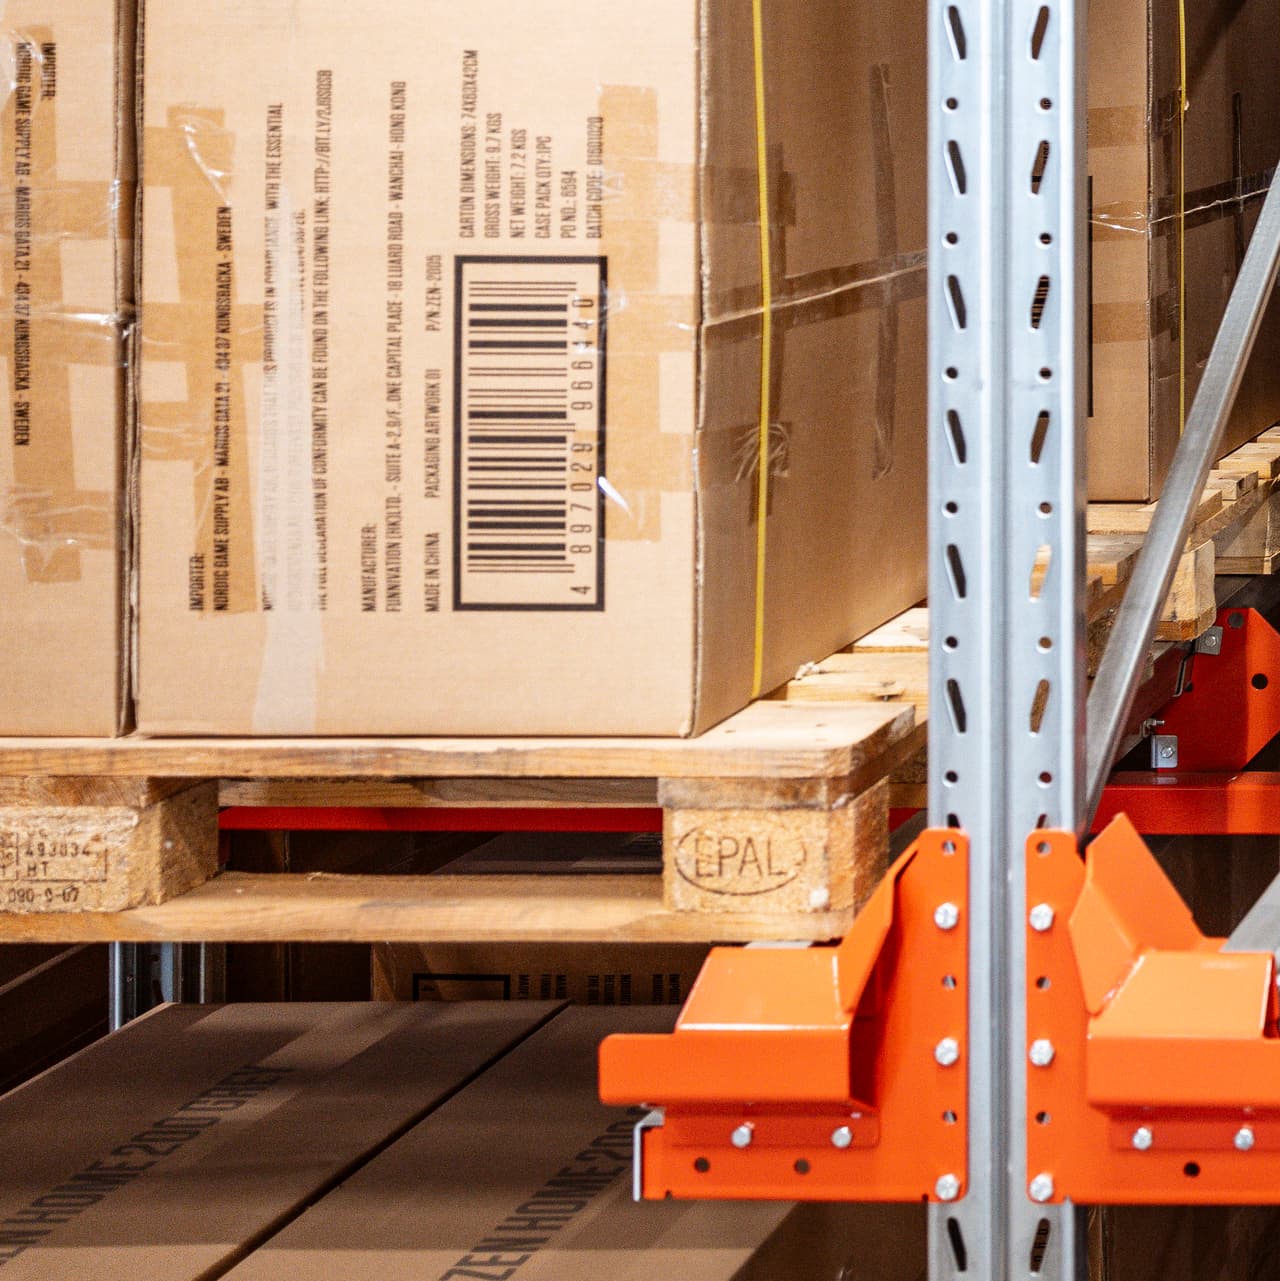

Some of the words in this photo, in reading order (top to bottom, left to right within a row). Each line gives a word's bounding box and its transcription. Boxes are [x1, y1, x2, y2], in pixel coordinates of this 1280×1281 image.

[41, 42, 56, 100] IMPORTER:
[387, 82, 406, 110] KONG
[265, 105, 282, 158] ESSENTIAL
[484, 112, 502, 133] KGS
[510, 129, 527, 149] KGS
[484, 136, 502, 152] 9.7
[585, 116, 604, 164] 01601020
[265, 162, 282, 178] THE
[459, 126, 478, 192] DIMENSIONS:
[510, 152, 527, 168] 7.2
[484, 156, 502, 199] WEIGHT:
[510, 173, 527, 215] WEIGHT:
[560, 170, 578, 196] 6594
[585, 170, 604, 201] CODE:
[265, 183, 282, 208] WITH
[534, 181, 552, 208] PACK
[560, 200, 577, 220] NO.:
[215, 207, 232, 251] SWEDEN
[387, 212, 405, 240] ROAD
[459, 196, 477, 237] CARTON
[484, 202, 502, 237] GROSS
[510, 219, 527, 237] NET
[534, 212, 552, 238] CASE
[560, 224, 577, 238] PO
[585, 204, 603, 238] BATCH
[313, 227, 331, 285] FOLLOWING
[387, 244, 404, 278] LUARD
[215, 262, 232, 333] KUNGSBACKA
[387, 281, 404, 290] 18
[424, 255, 440, 331] P/N:ZEN-2005
[313, 311, 330, 324] ON
[387, 302, 404, 332] PLACE
[313, 328, 330, 362] FOUND
[386, 337, 404, 378] CAPITAL
[313, 366, 330, 378] BE
[214, 395, 231, 422] GATA
[313, 382, 330, 402] CAN
[424, 382, 440, 434] ARTWORK
[214, 424, 231, 466] MARIOS
[312, 406, 330, 474] CONFORMITY
[386, 454, 403, 481] SUITE
[424, 438, 440, 497] PACKAGING
[214, 478, 231, 491] AB
[214, 494, 231, 535] SUPPLY
[214, 538, 230, 567] GAME
[424, 533, 440, 565] CHINA
[189, 553, 205, 611] IMPORTER:
[361, 524, 377, 611] MANUFACTURER:
[386, 542, 402, 612] FUNNIVATION
[424, 568, 440, 578] IN
[214, 570, 230, 610] NORDIC
[424, 583, 440, 611] MADE
[692, 834, 787, 879] EPAL
[18, 1157, 141, 1230] HOME
[113, 1111, 205, 1172] 200
[210, 1063, 296, 1127] GREY
